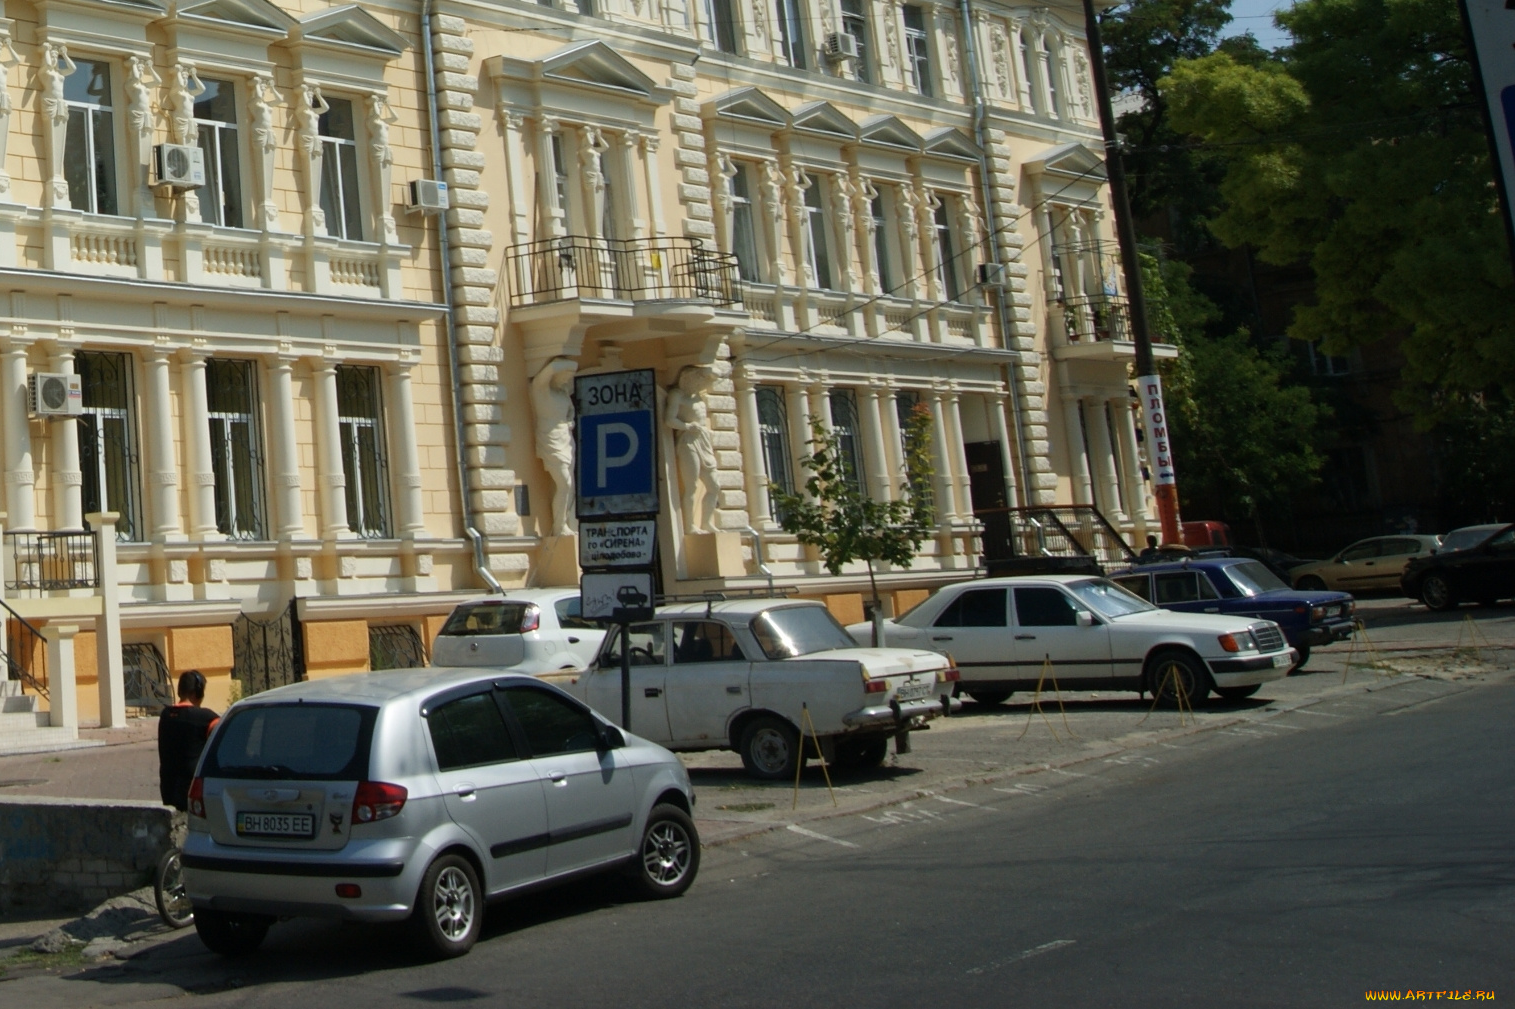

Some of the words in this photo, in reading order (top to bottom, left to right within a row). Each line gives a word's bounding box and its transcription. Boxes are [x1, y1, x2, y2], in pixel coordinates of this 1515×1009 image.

[588, 382, 642, 406] ЗОНА
[1147, 384, 1172, 468] ПЛОМБЫ
[597, 422, 639, 488] P
[263, 817, 290, 831] 8035
[292, 817, 310, 832] EE
